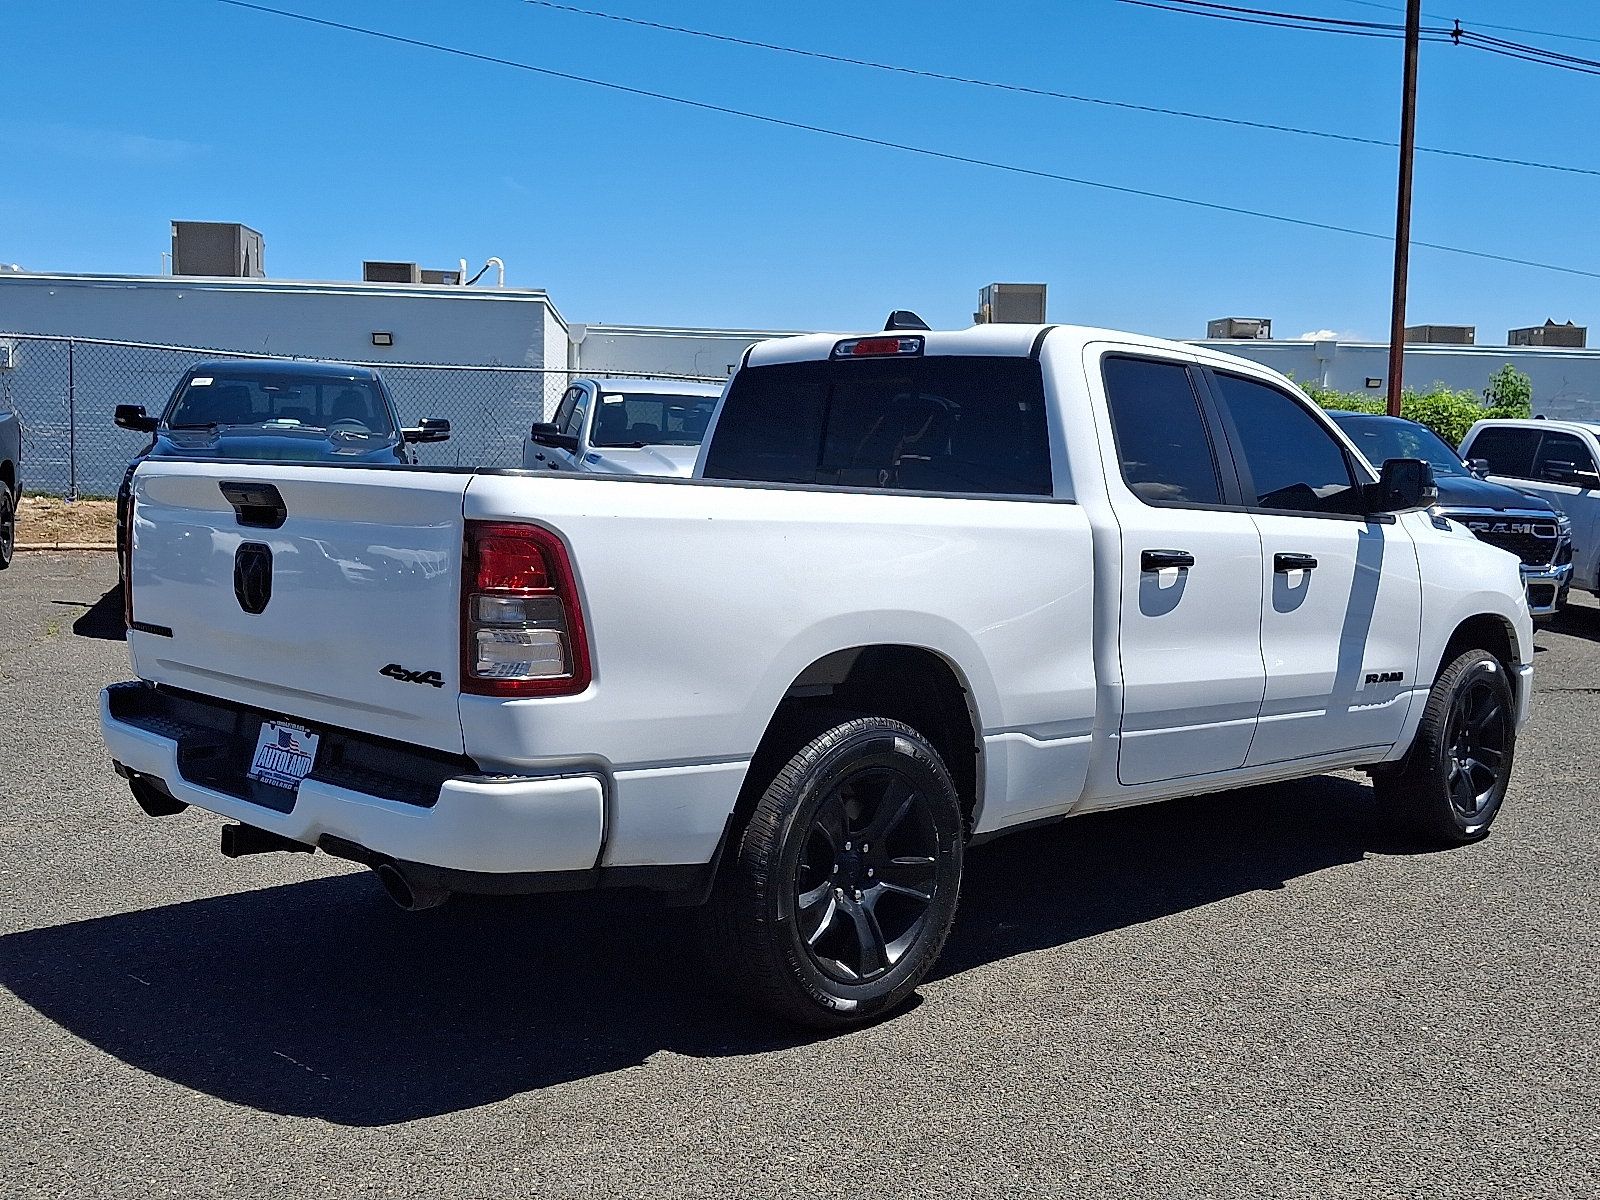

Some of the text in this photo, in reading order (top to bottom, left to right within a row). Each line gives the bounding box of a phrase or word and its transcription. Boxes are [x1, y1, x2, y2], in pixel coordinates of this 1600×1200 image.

[1468, 521, 1531, 534] RAM
[1365, 671, 1404, 685] RAM
[256, 746, 311, 778] AUTOLAND
